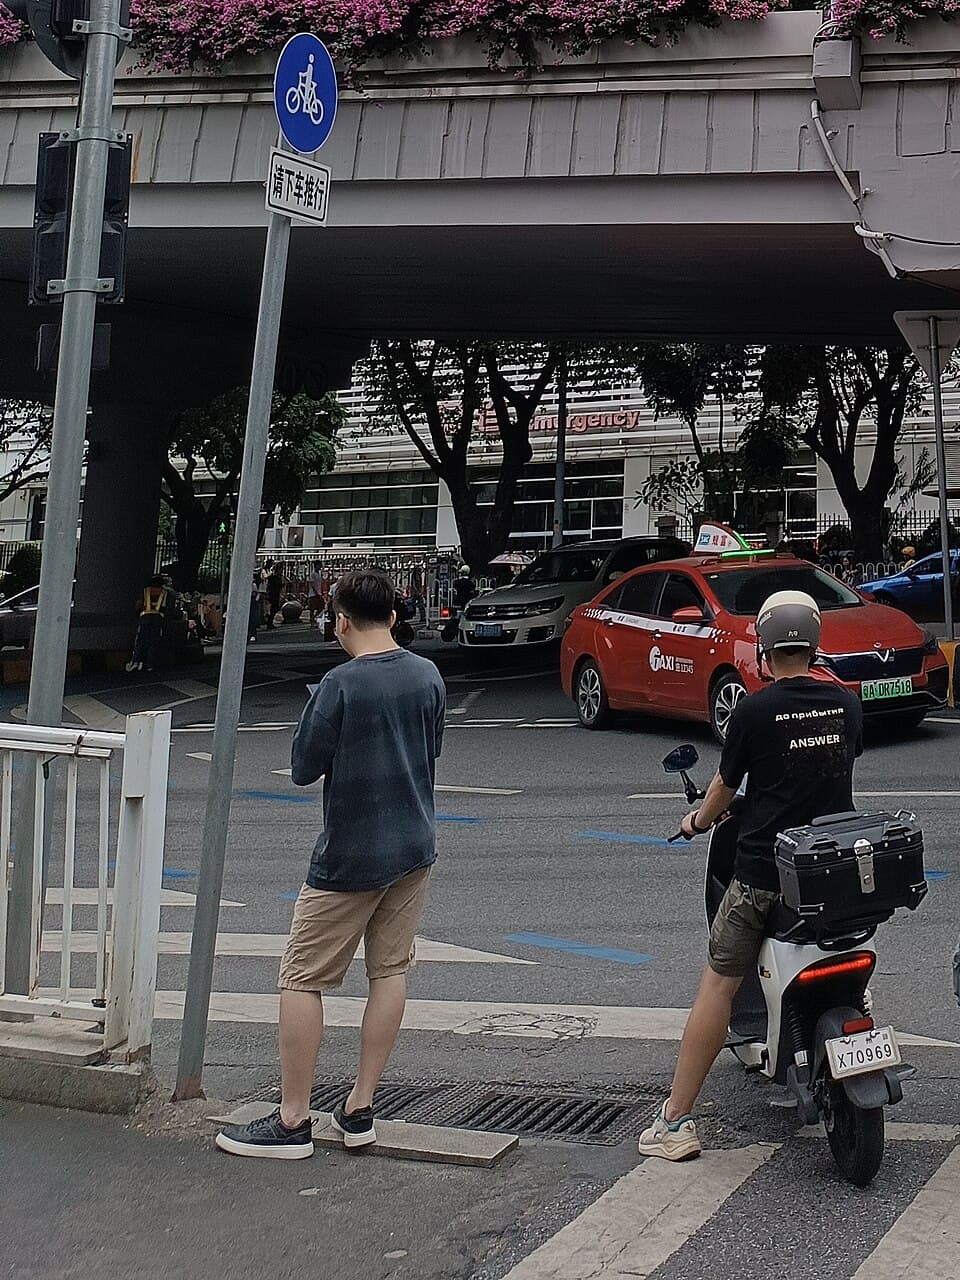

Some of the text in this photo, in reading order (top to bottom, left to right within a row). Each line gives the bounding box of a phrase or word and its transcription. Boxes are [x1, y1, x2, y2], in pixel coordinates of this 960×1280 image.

[272, 163, 325, 212] 请下车推行
[878, 678, 912, 697] DR7518
[788, 733, 841, 750] ANSWER
[837, 1043, 892, 1069] X70969
